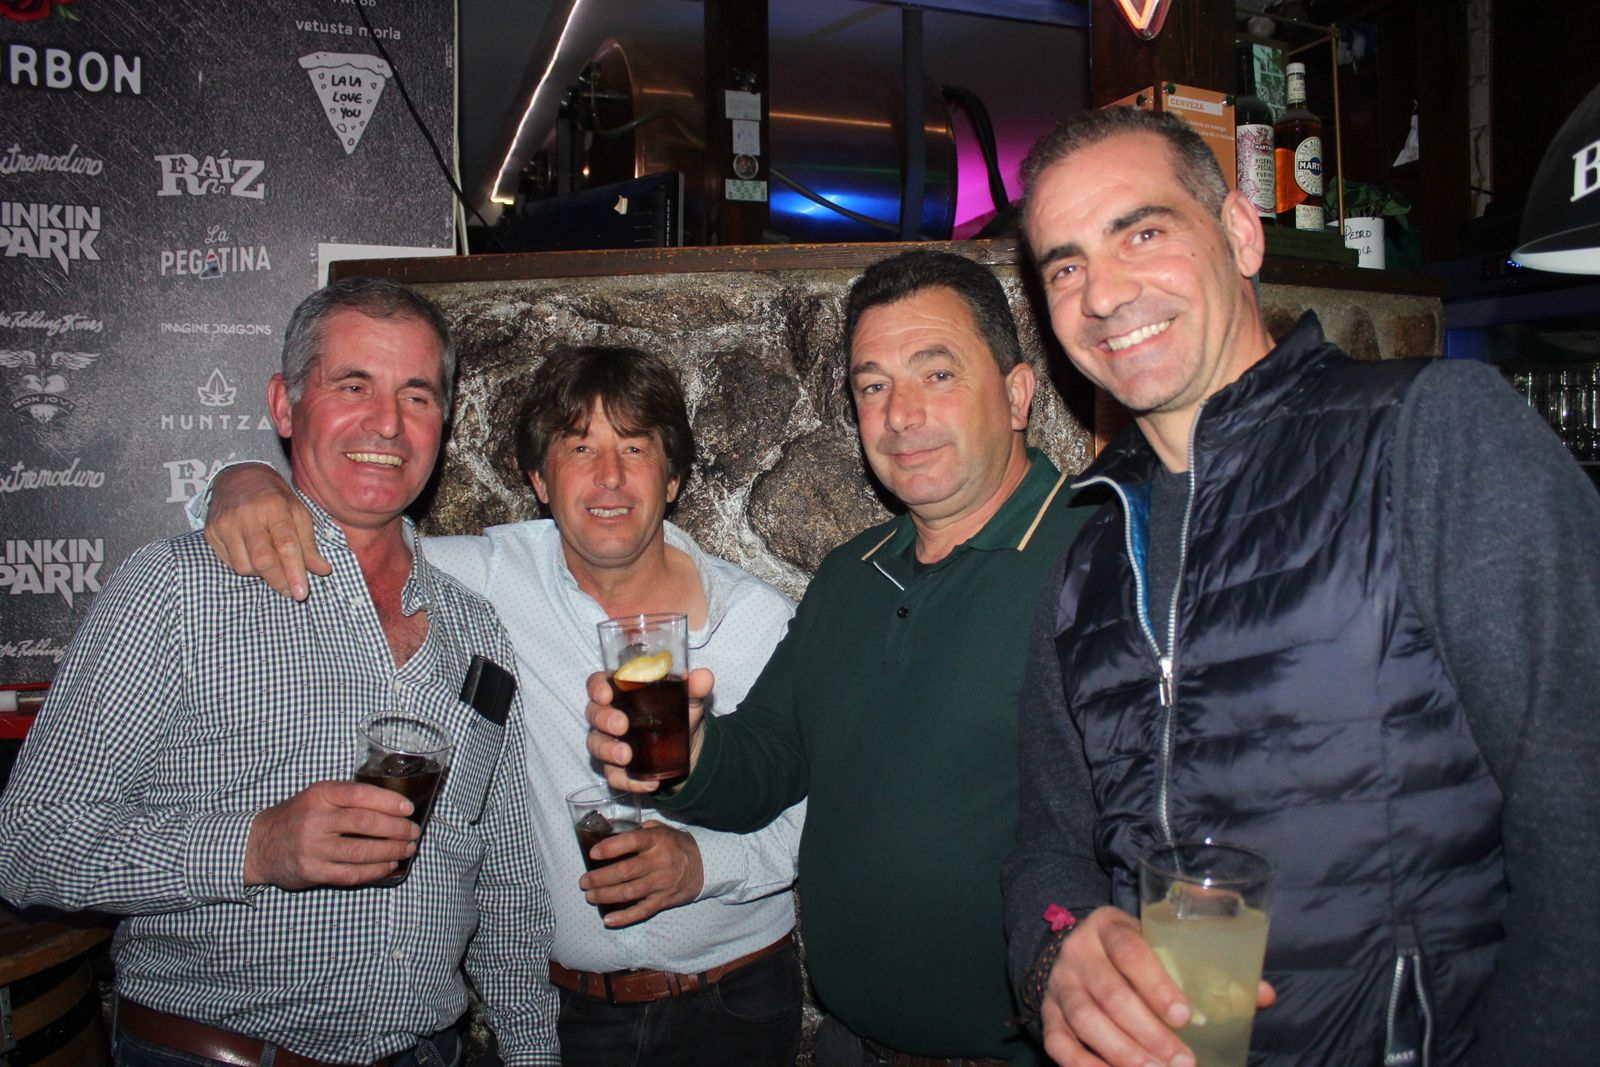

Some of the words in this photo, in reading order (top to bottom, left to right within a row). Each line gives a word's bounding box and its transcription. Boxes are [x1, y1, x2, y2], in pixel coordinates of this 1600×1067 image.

[295, 20, 353, 35] vetusta
[333, 92, 362, 103] LOVE
[1169, 98, 1205, 111] CERVEZA
[340, 107, 361, 119] YOU
[204, 225, 229, 244] La
[1345, 225, 1372, 241] PEDRO
[160, 246, 271, 279] PEGATINA
[10, 311, 62, 336] Rolling
[160, 323, 209, 333] IMAGINE
[211, 323, 271, 335] DRAGONS
[160, 414, 272, 430] HUNTZA
[0, 538, 104, 574] INKIN
